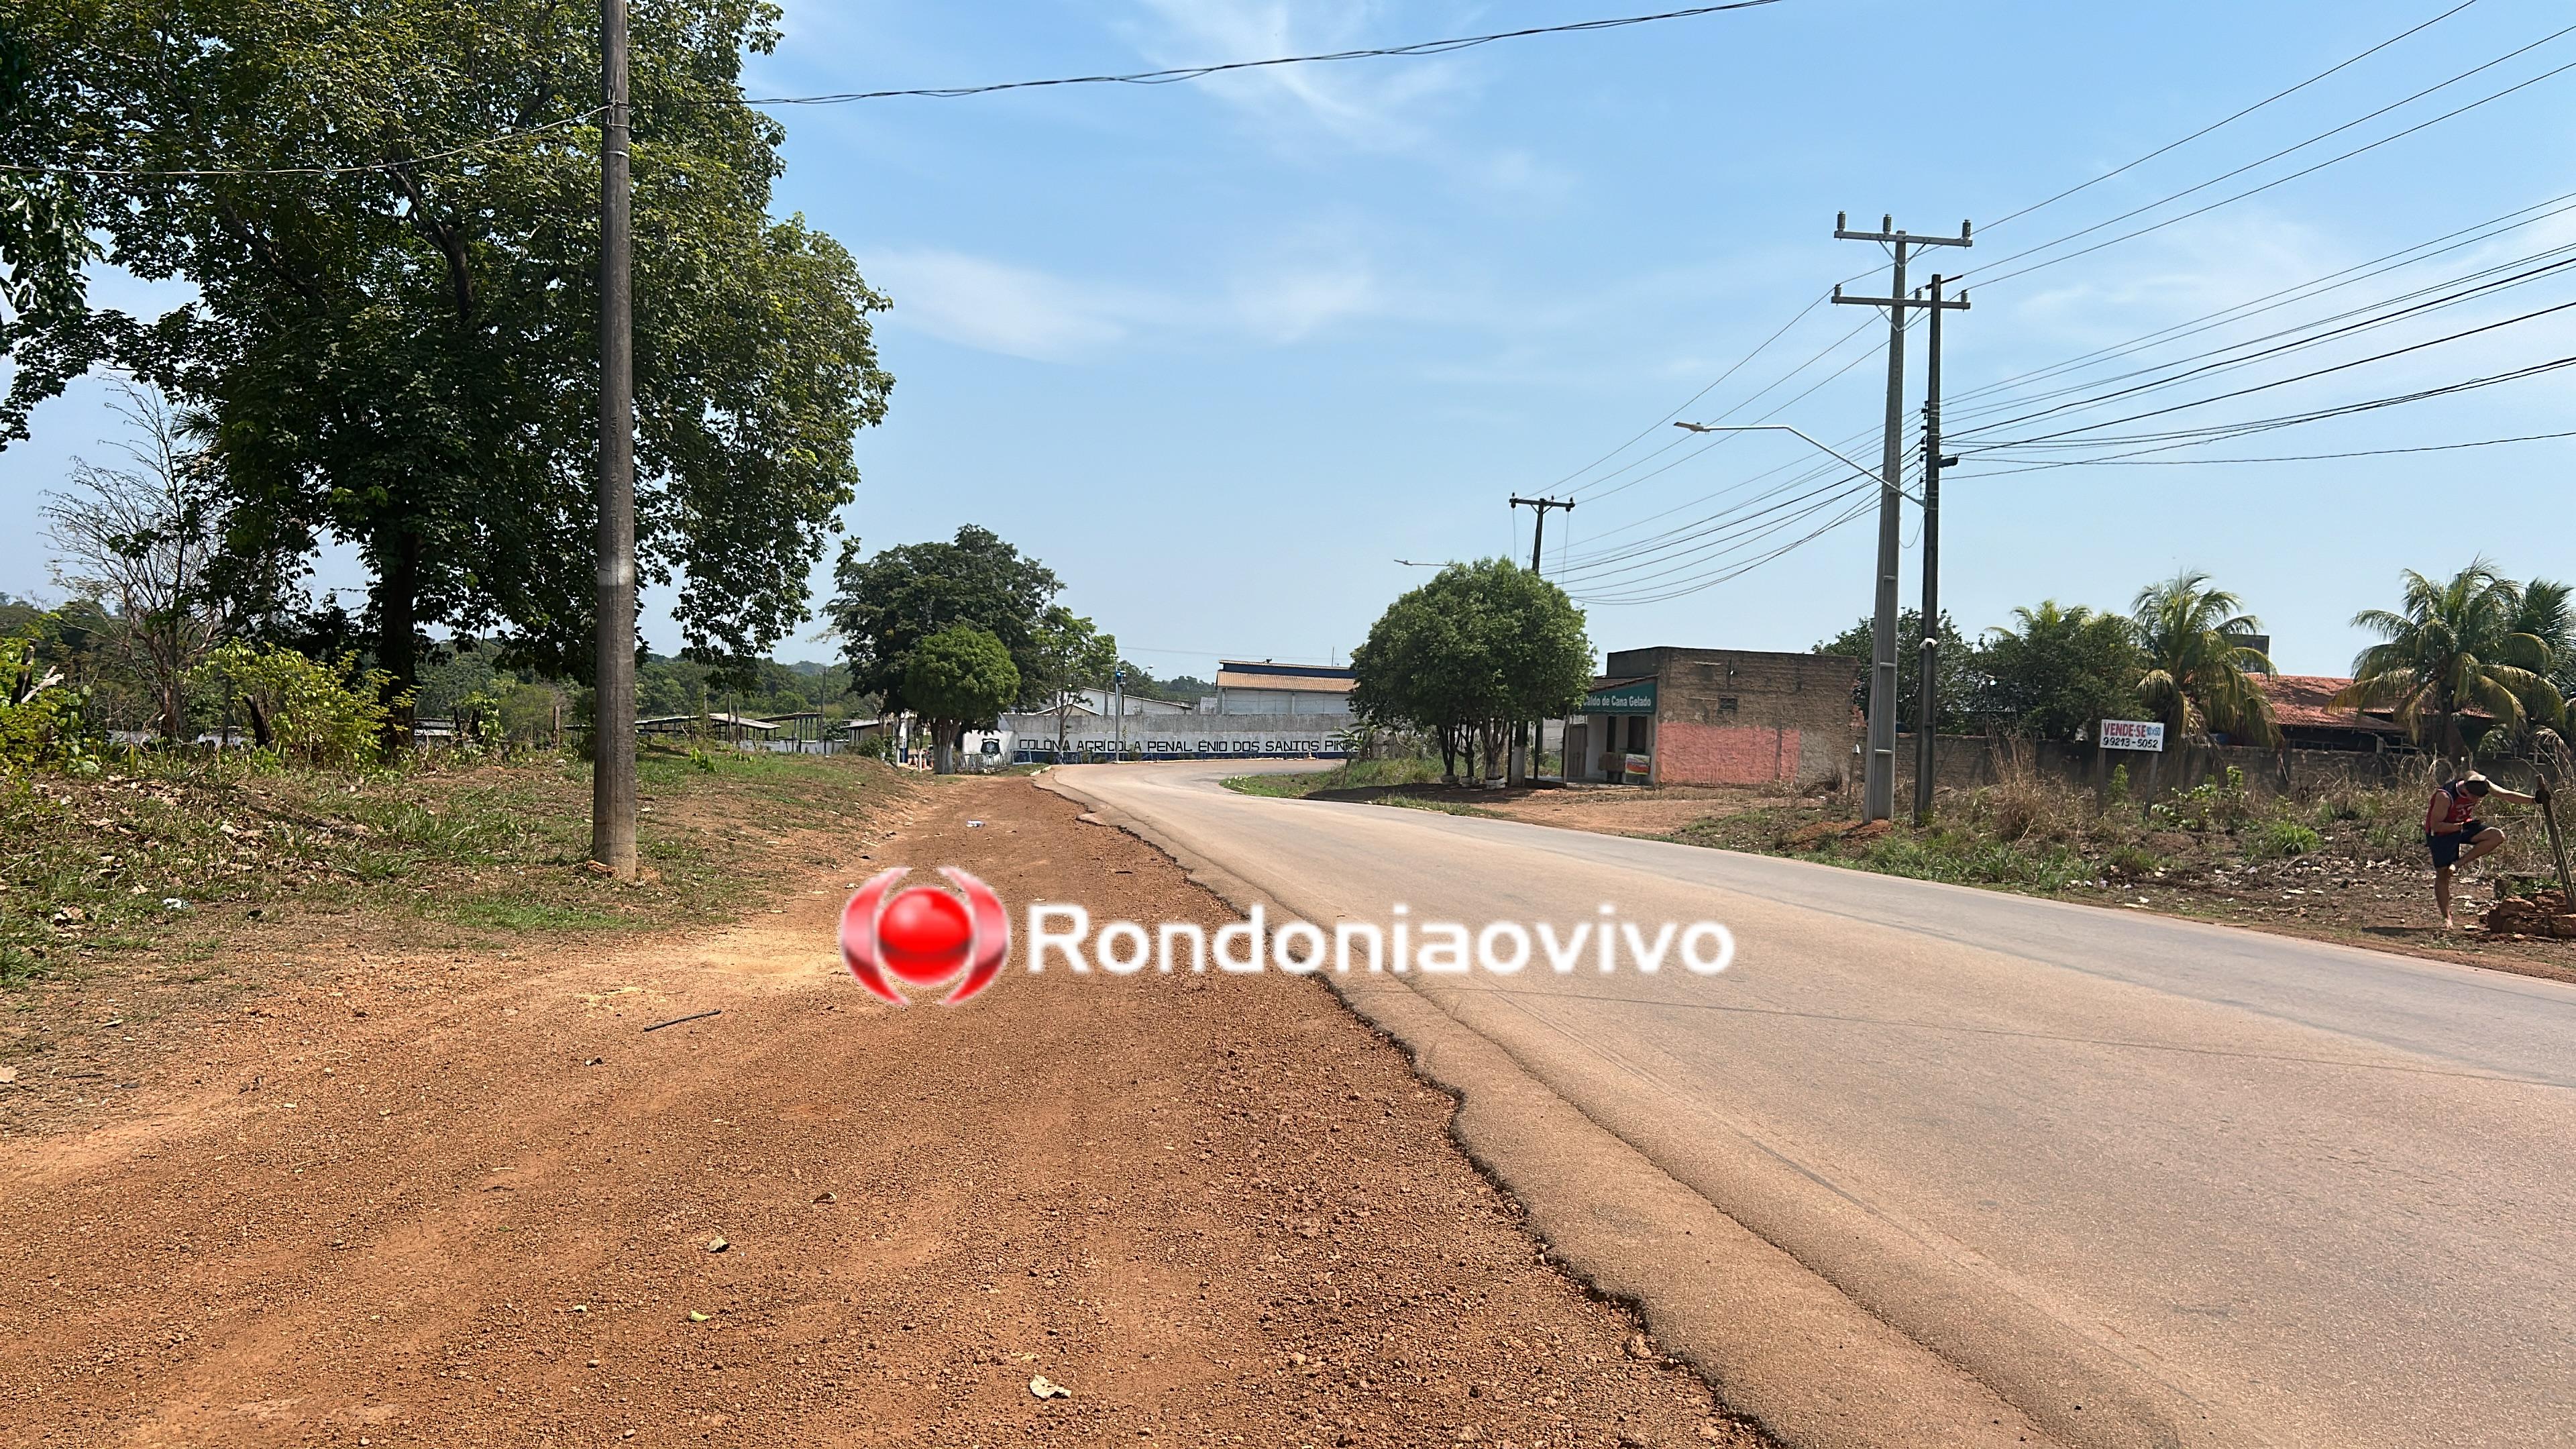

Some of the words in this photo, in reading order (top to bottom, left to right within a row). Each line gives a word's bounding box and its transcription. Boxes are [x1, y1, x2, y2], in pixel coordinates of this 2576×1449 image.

[1602, 696, 1610, 706] de
[1611, 696, 1627, 706] Cana
[1629, 696, 1651, 706] Gelado
[1020, 739, 1071, 751] COLÔNA
[1077, 739, 1142, 751] AGRÍCOLA
[1148, 741, 1192, 752] PENAL
[1198, 739, 1228, 752] ÊNIO
[1233, 741, 1260, 752] DOS
[1266, 741, 1320, 752] SANTOS
